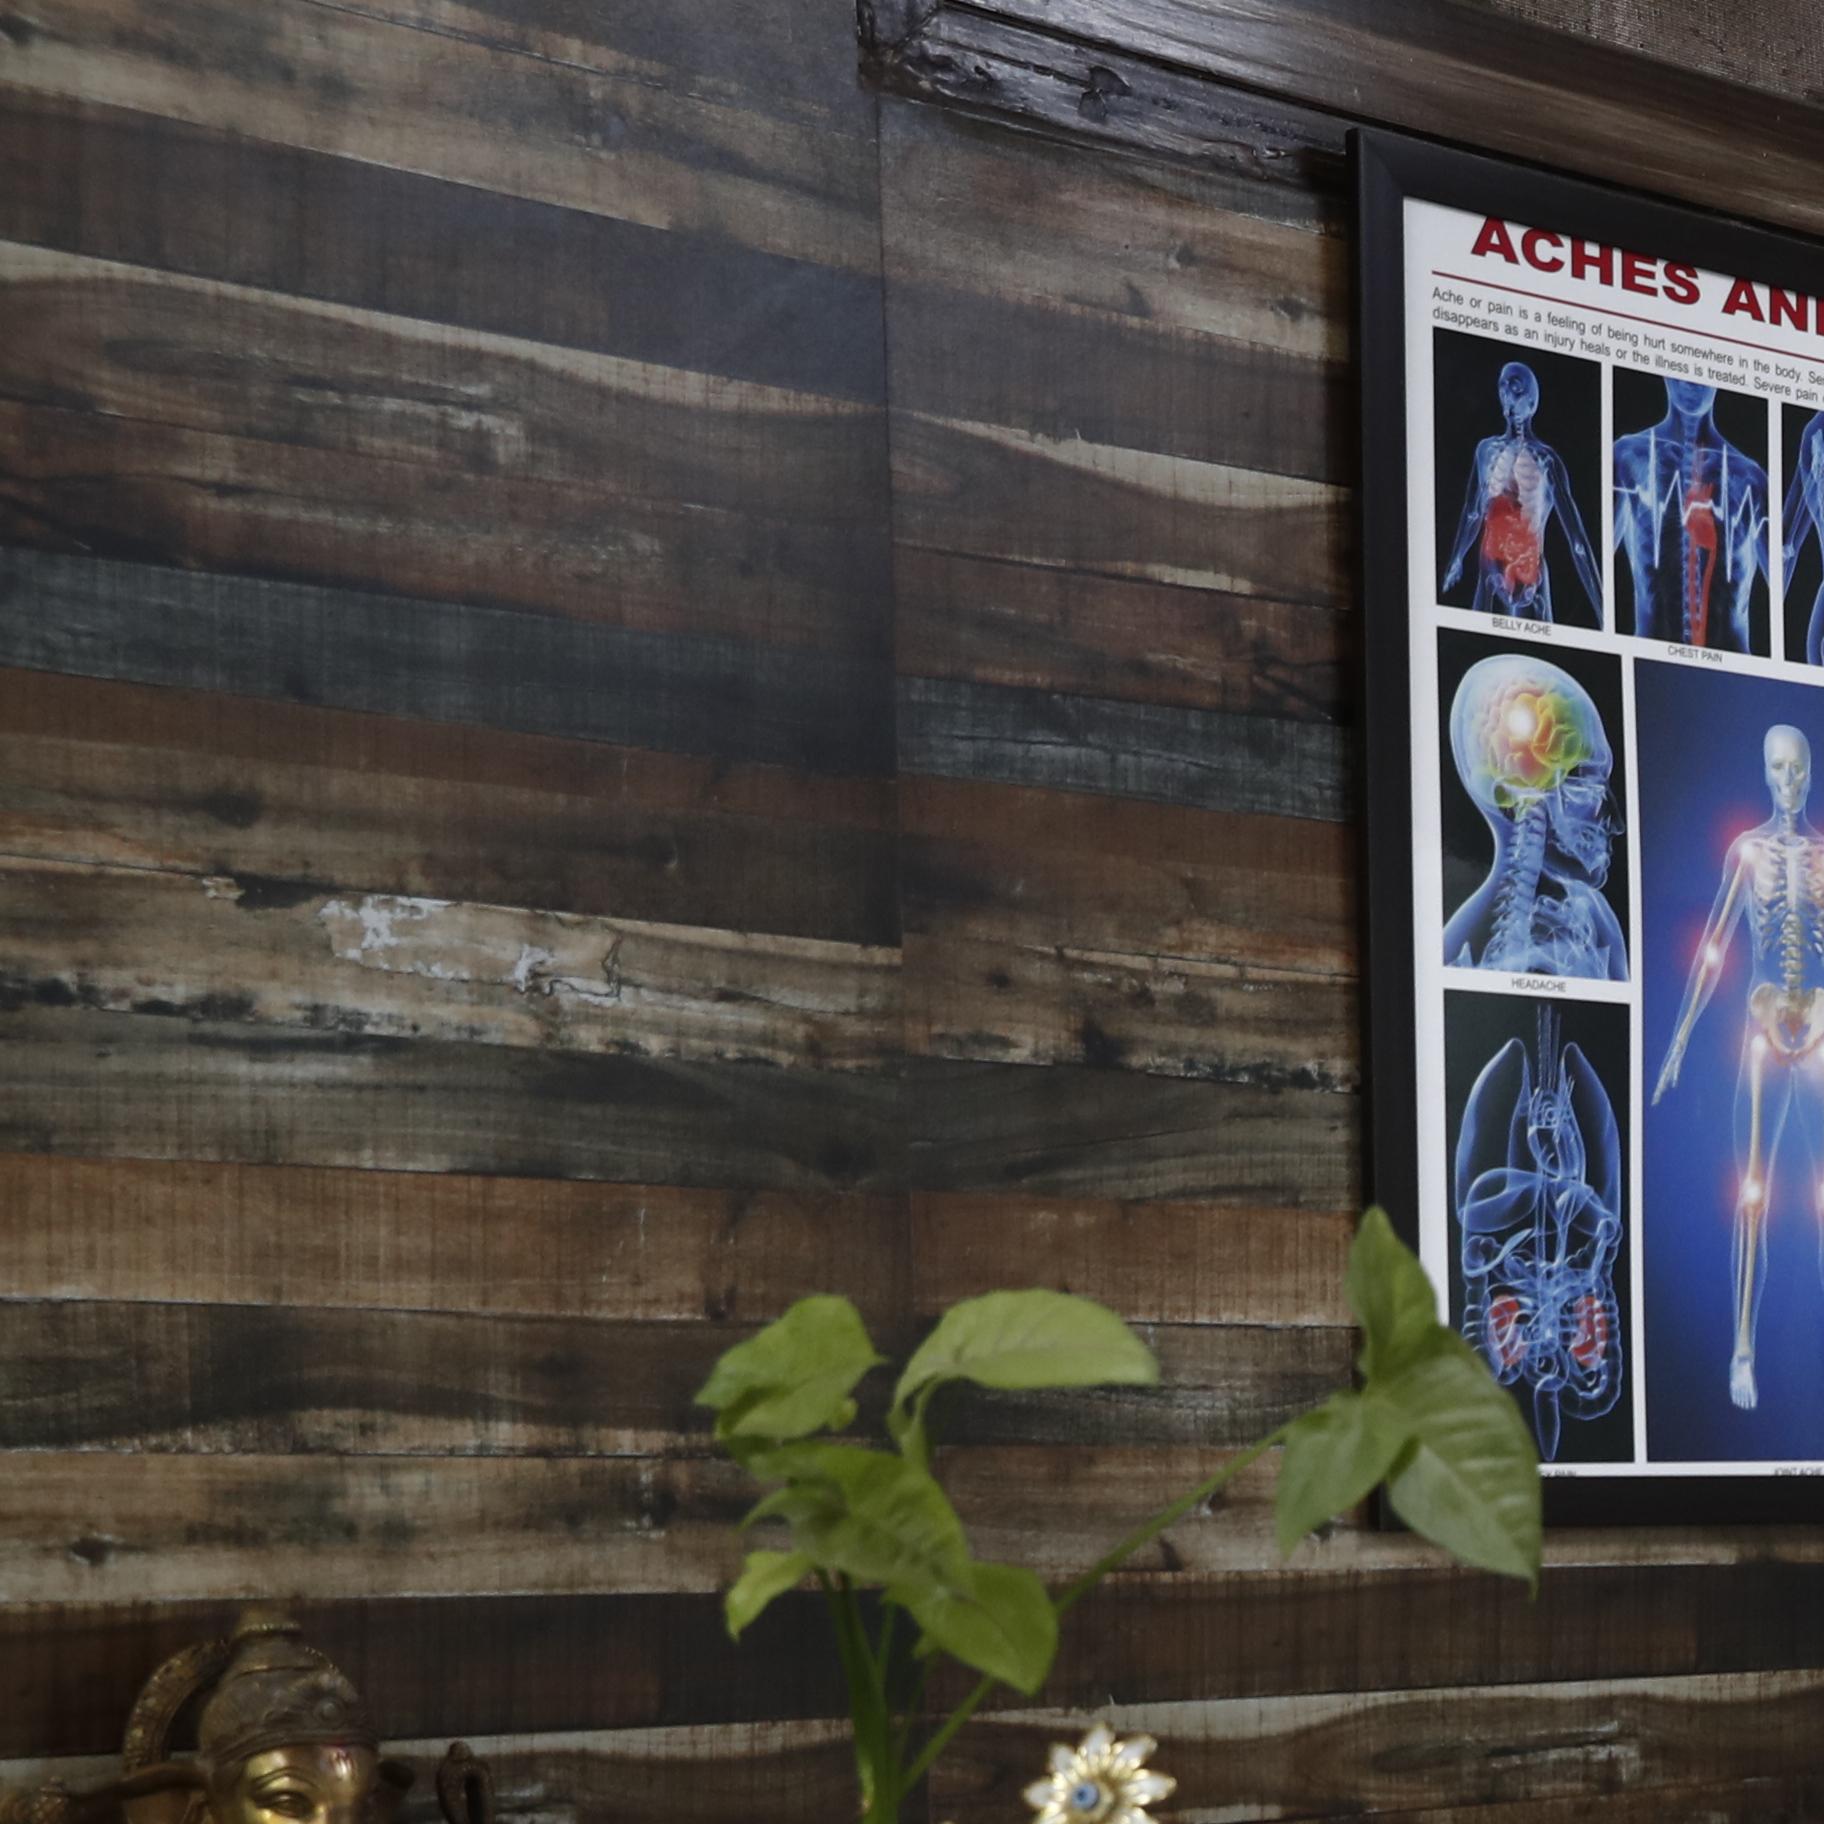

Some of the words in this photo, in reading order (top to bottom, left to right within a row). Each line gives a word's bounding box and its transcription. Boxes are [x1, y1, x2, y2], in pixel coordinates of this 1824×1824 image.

[1471, 217, 1700, 305] ACHES
[1433, 287, 1463, 306] Ache
[1470, 297, 1481, 308] or
[1488, 299, 1513, 318] pain
[1519, 306, 1528, 319] is
[1534, 312, 1541, 322] a
[1548, 312, 1585, 335] feeling
[1592, 323, 1602, 335] of
[1608, 326, 1638, 347] being
[1644, 334, 1665, 350] hurt
[1671, 343, 1734, 366] somewhere
[1739, 356, 1748, 369] in
[1754, 358, 1770, 373] the
[1434, 308, 1498, 332] disappears
[1505, 325, 1518, 337] as
[1524, 330, 1538, 341] an
[1544, 330, 1575, 351] injury
[1581, 338, 1610, 356] heals
[1616, 348, 1628, 358] or
[1633, 349, 1650, 365] the
[1656, 355, 1688, 374] illness
[1694, 363, 1703, 376] is
[1754, 379, 1791, 397] Severe
[1796, 388, 1818, 406] pain
[1492, 617, 1522, 633] BELLY
[1524, 622, 1551, 636] ACHE
[1668, 645, 1700, 659] CHEST
[1702, 650, 1722, 662] PAIN
[1512, 978, 1566, 992] HEADACHE
